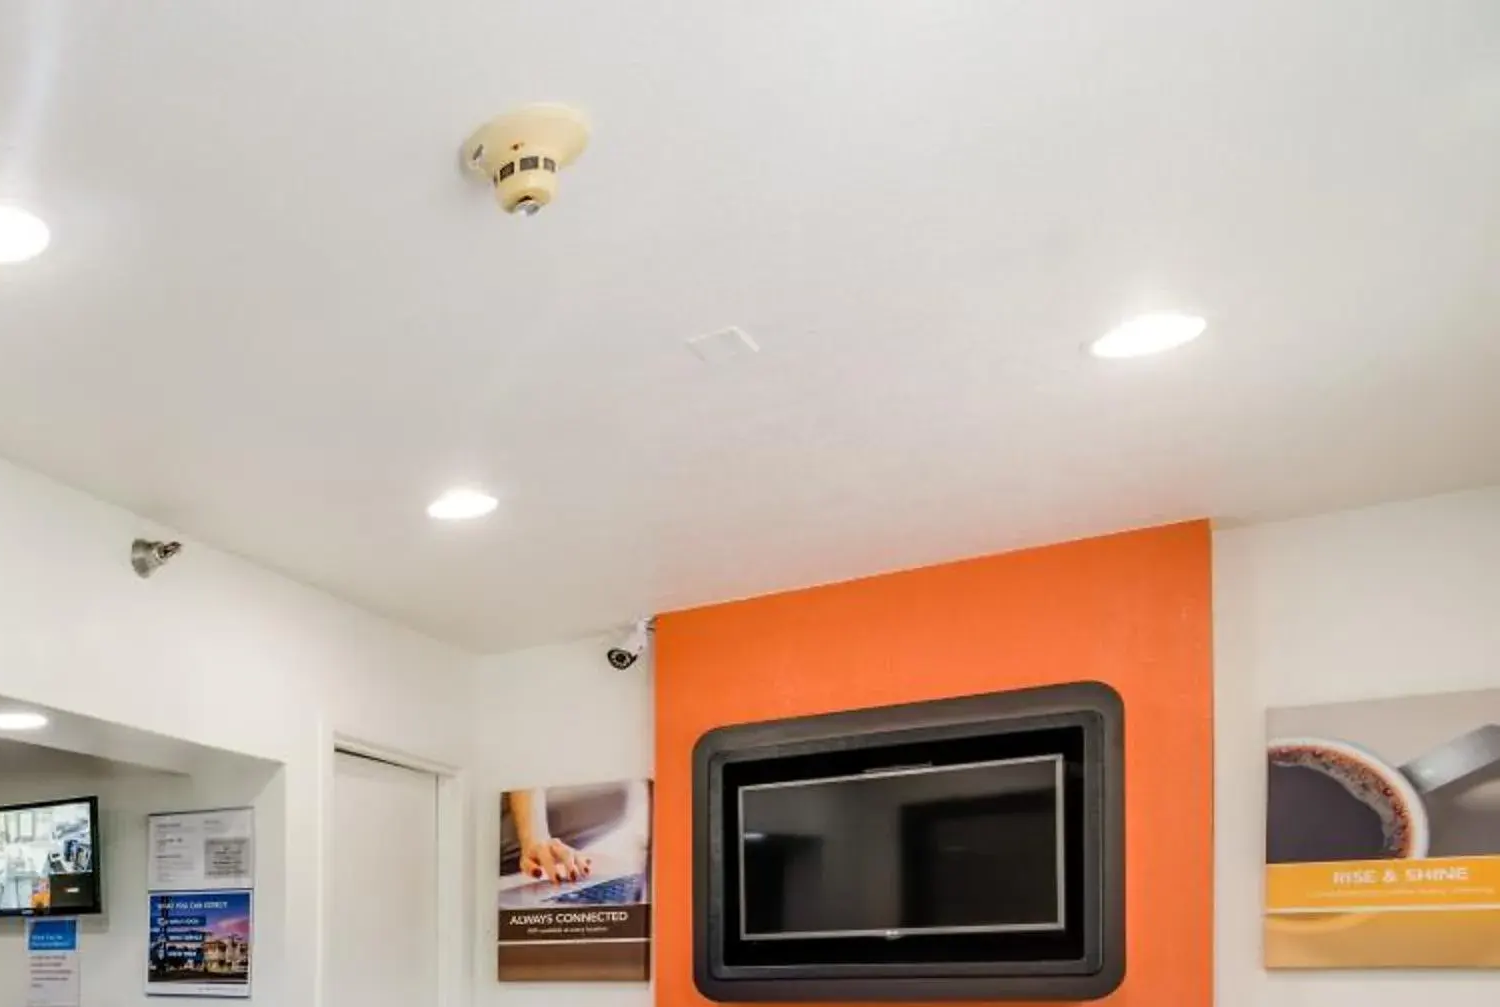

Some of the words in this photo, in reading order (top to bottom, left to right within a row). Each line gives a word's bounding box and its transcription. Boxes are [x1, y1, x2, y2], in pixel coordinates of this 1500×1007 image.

[1332, 870, 1378, 885] RISE
[1405, 866, 1470, 882] SHINE
[509, 914, 553, 926] ALWAYS
[555, 911, 629, 924] CONNECTED
